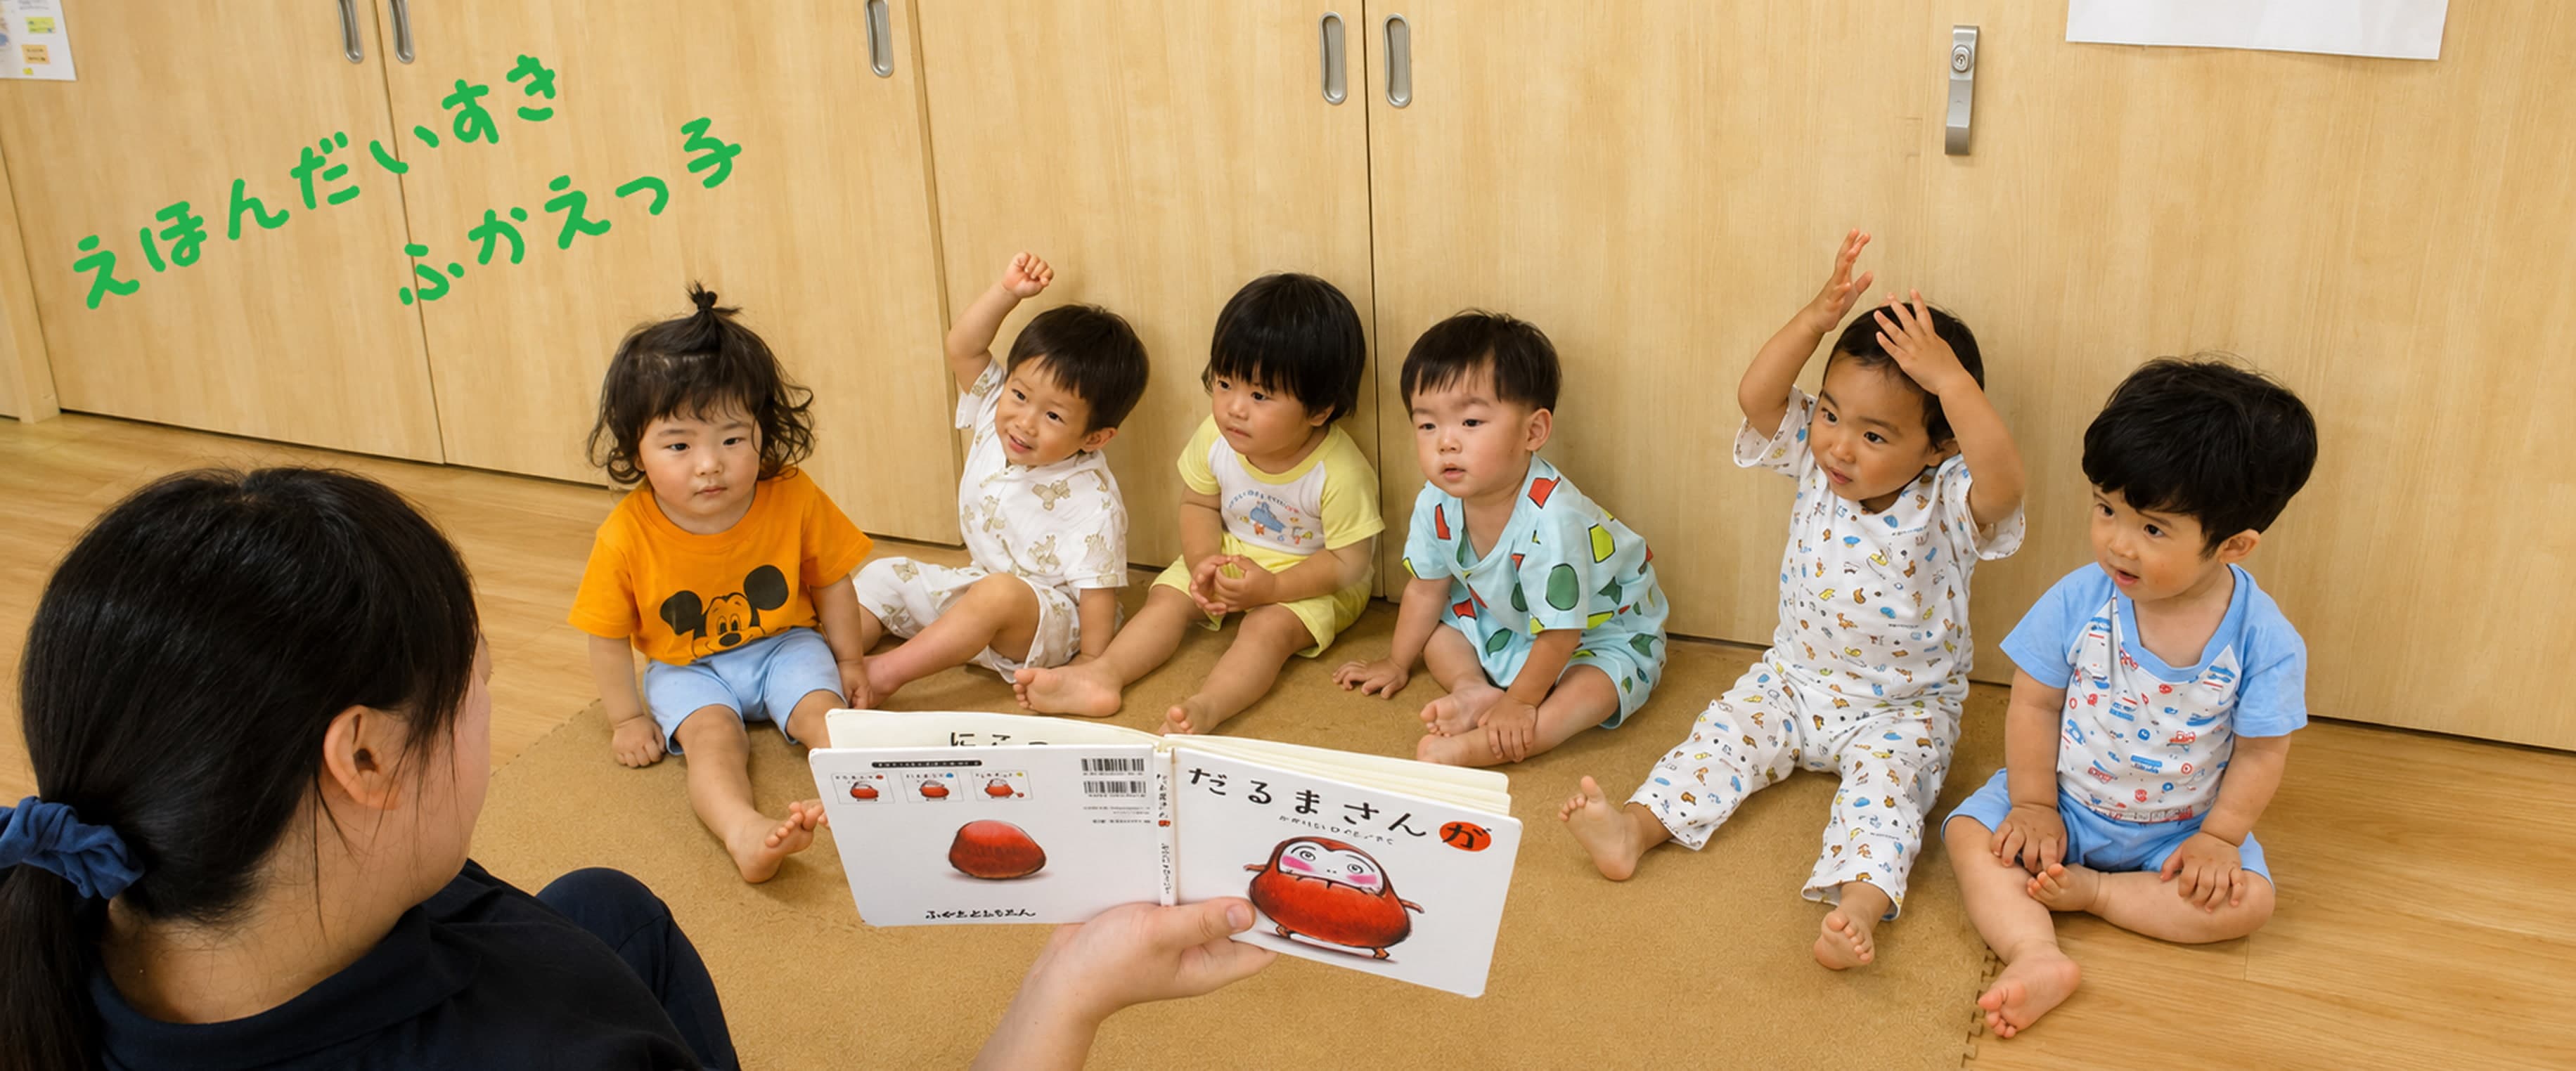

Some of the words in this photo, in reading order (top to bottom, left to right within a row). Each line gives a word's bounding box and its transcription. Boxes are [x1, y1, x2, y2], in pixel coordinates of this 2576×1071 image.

[1188, 767, 1492, 849] だるまさんが
